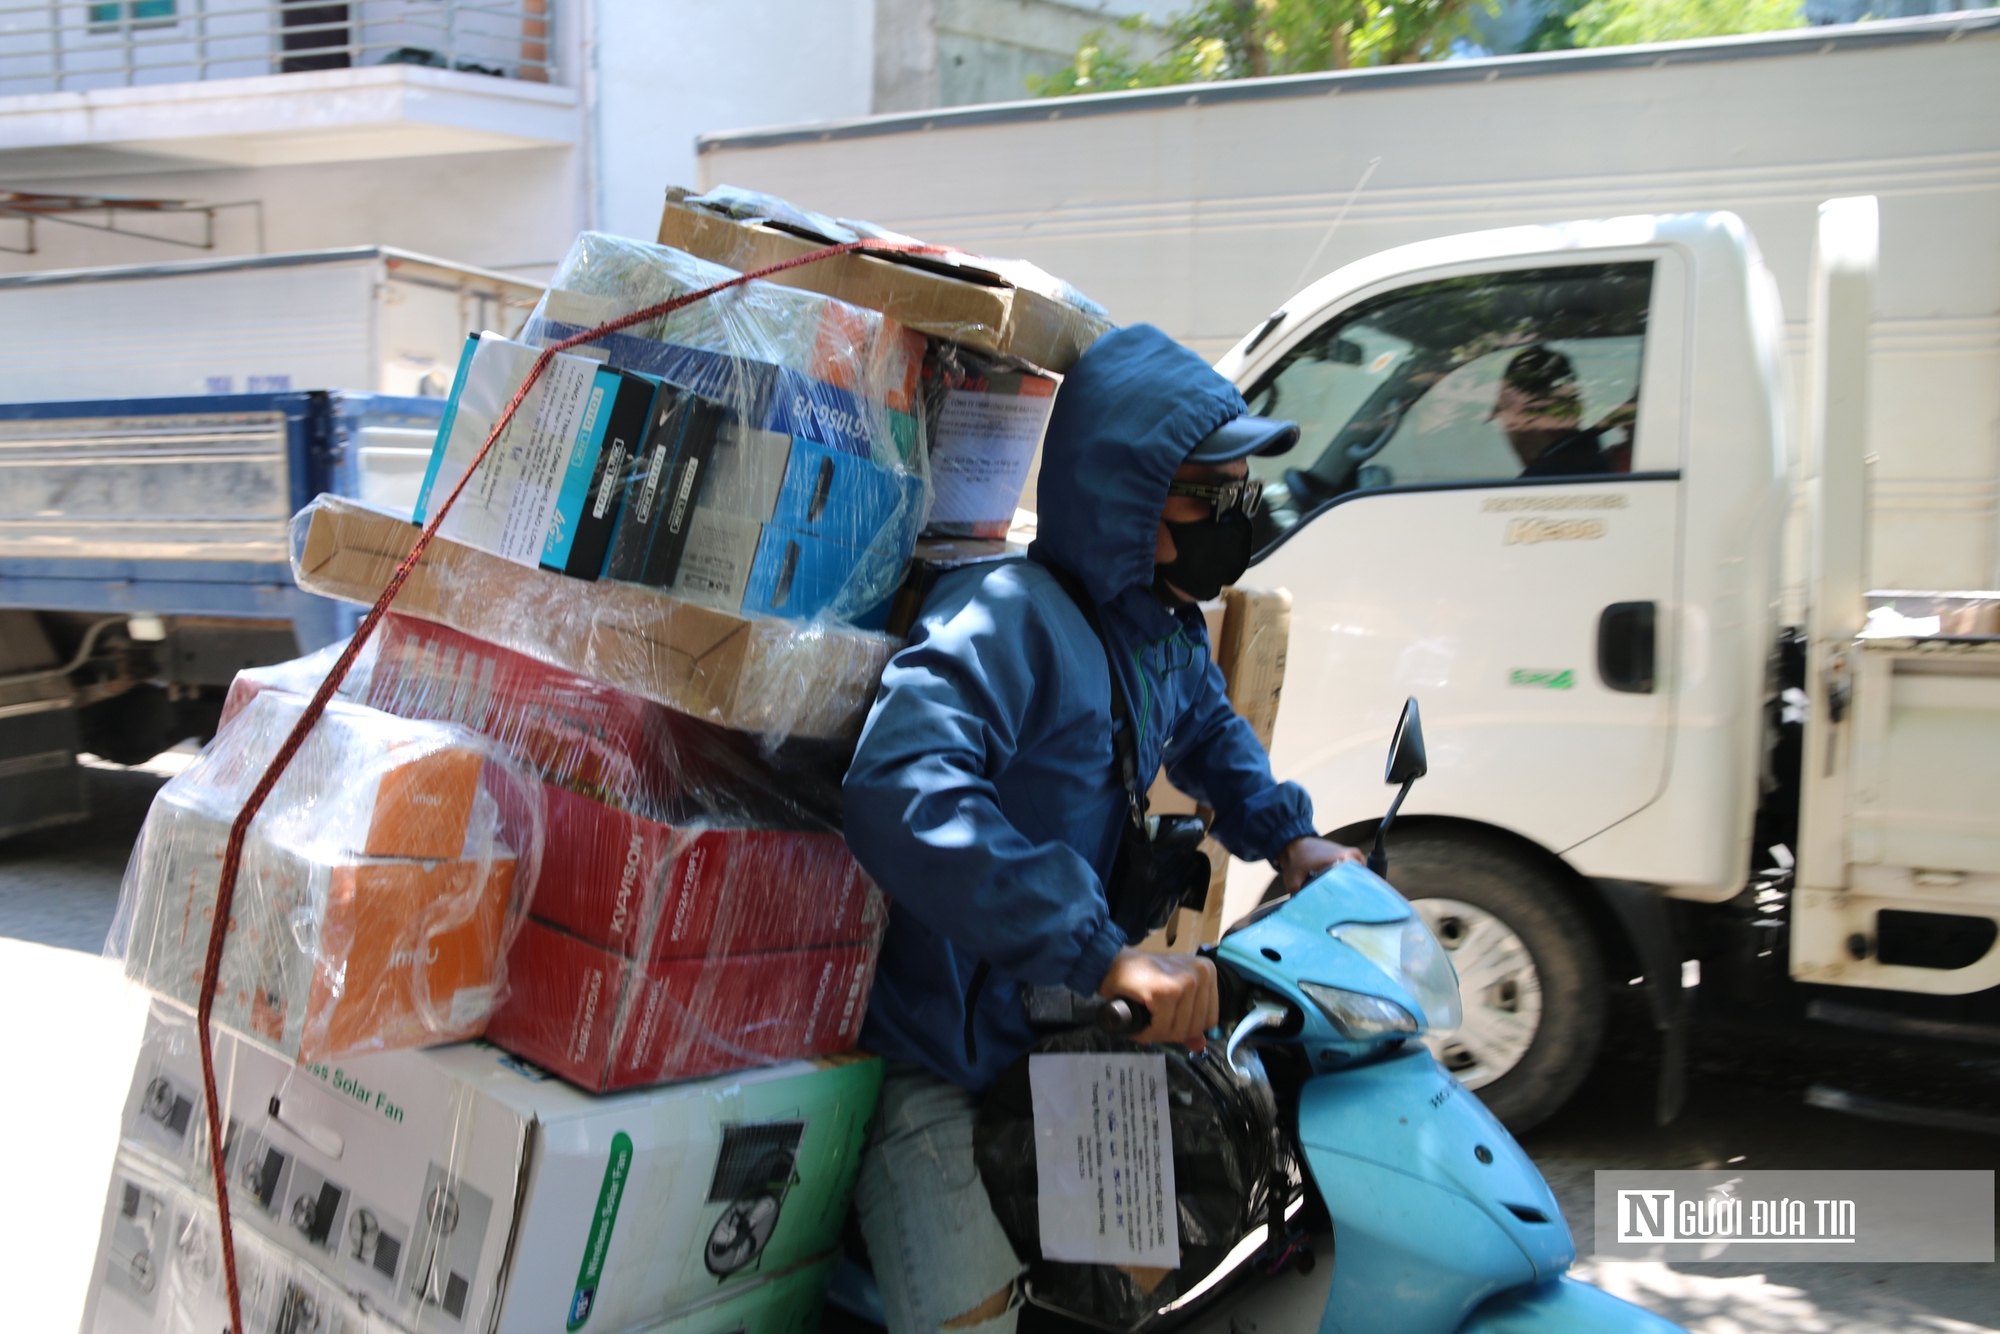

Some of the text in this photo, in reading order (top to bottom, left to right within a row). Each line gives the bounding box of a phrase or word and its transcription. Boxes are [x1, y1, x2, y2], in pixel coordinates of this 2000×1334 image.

[388, 946, 439, 968] imu
[330, 1066, 373, 1106] Solar
[372, 1089, 407, 1125] Fan
